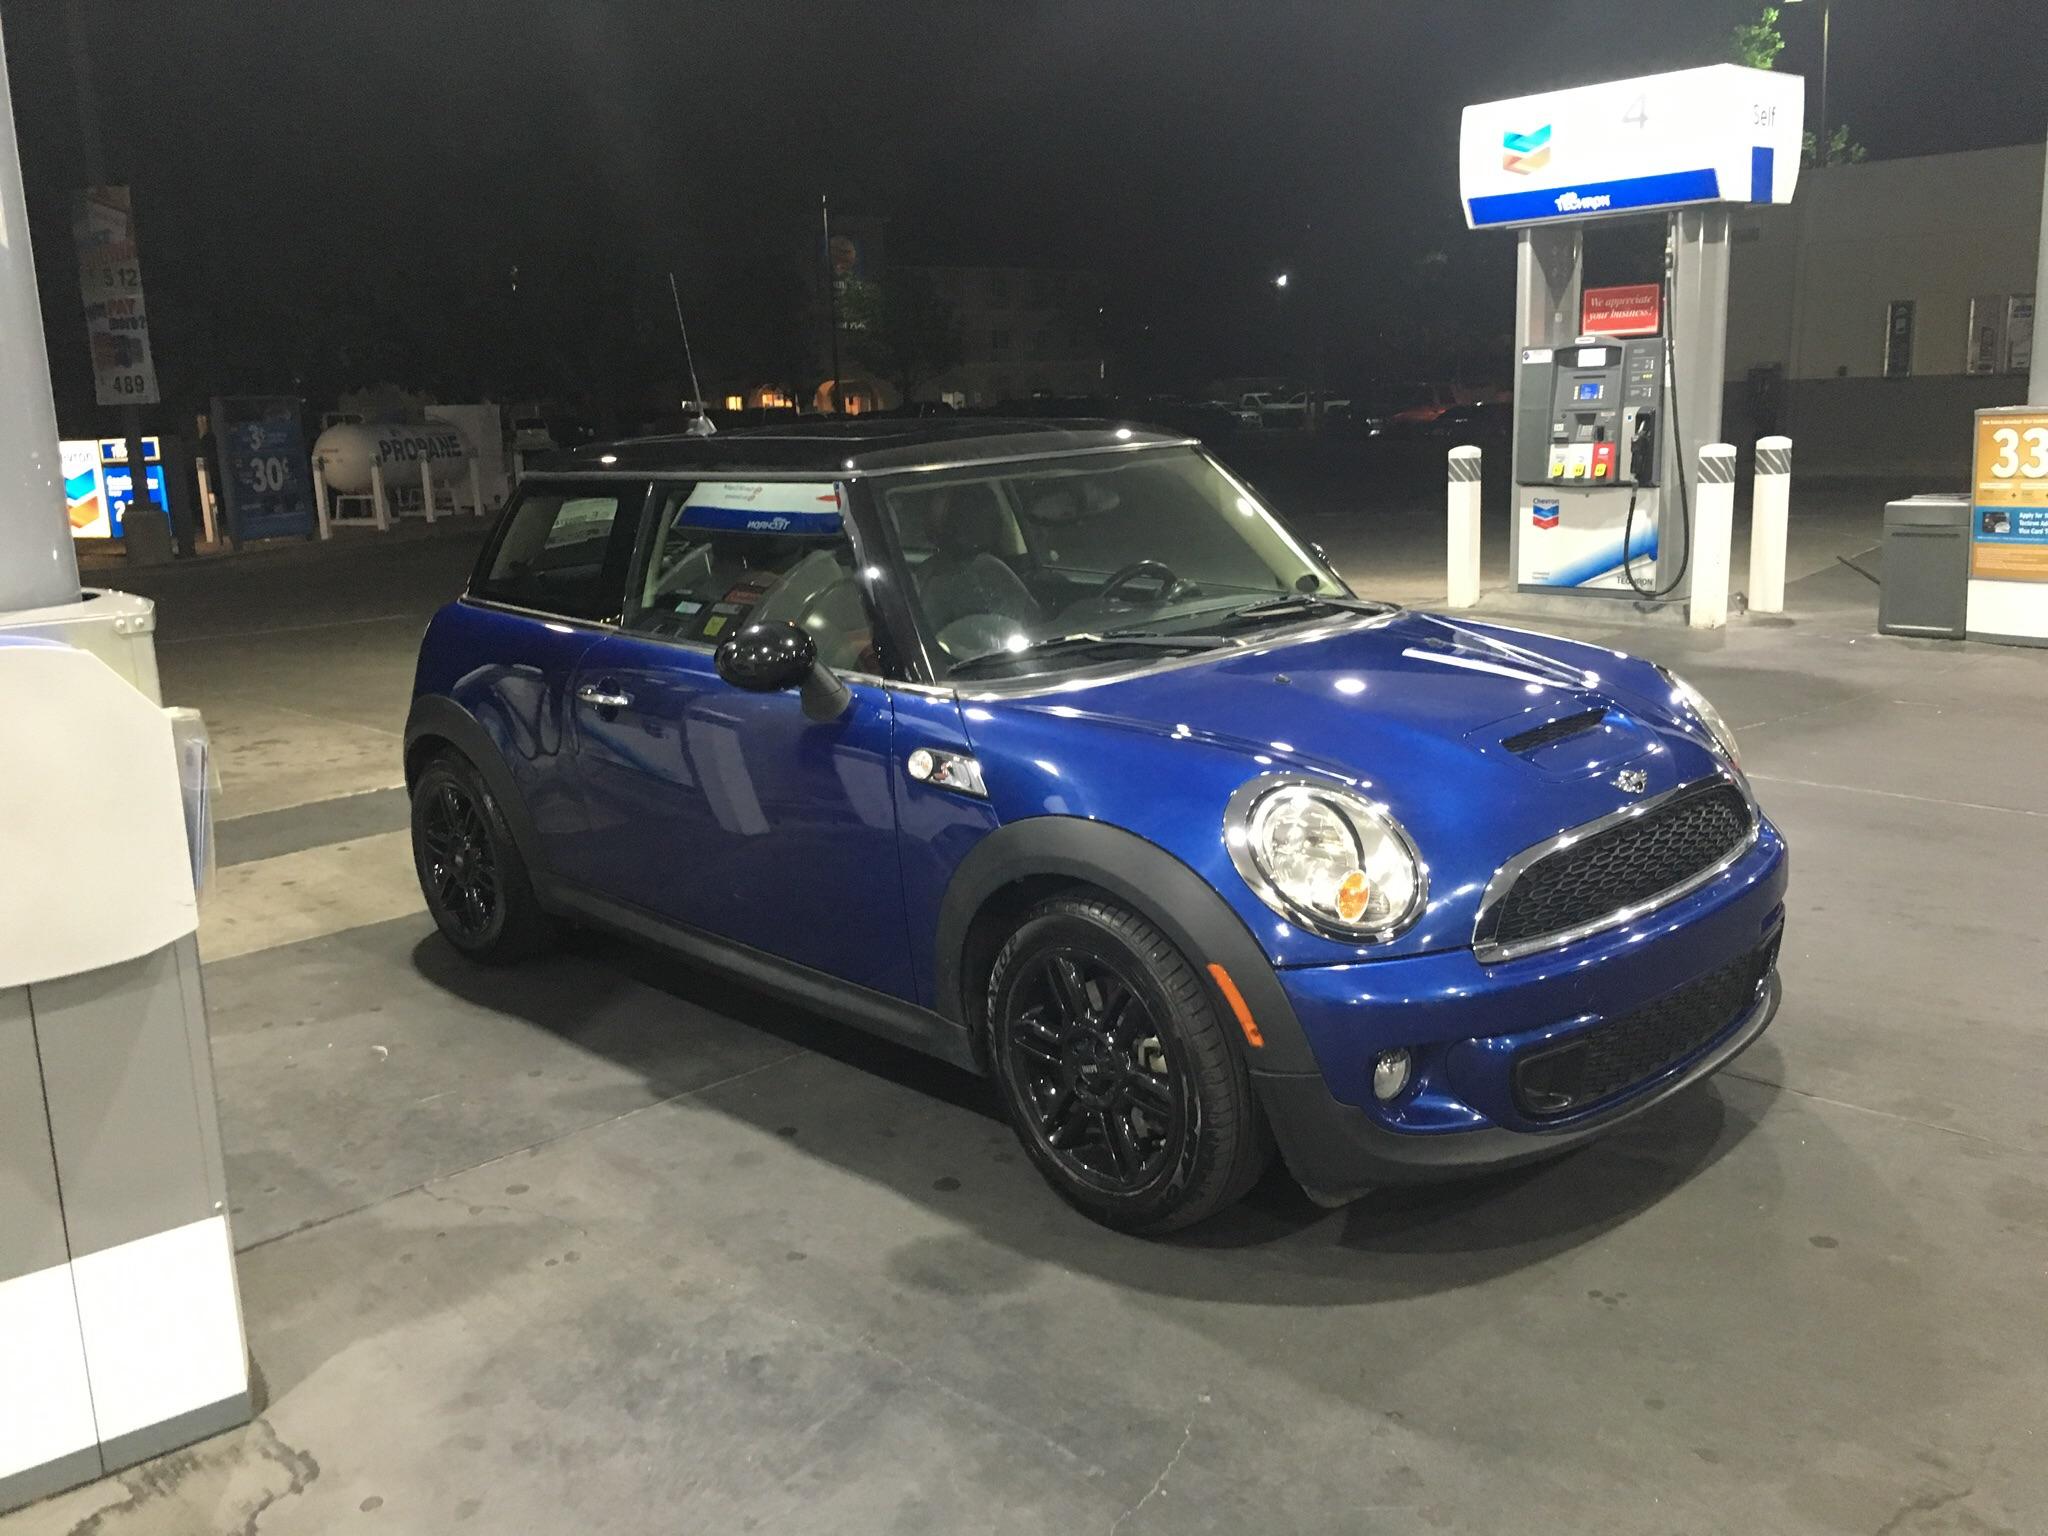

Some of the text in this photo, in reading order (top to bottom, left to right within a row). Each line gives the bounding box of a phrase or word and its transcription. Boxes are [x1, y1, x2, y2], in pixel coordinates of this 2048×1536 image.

[1621, 92, 1649, 131] 4
[1752, 103, 1777, 129] Self
[1591, 295, 1653, 309] We appreciate
[1587, 306, 1654, 323] your business!
[113, 374, 145, 394] 489
[378, 434, 463, 463] PROPANE
[1533, 497, 1560, 505] Chevron
